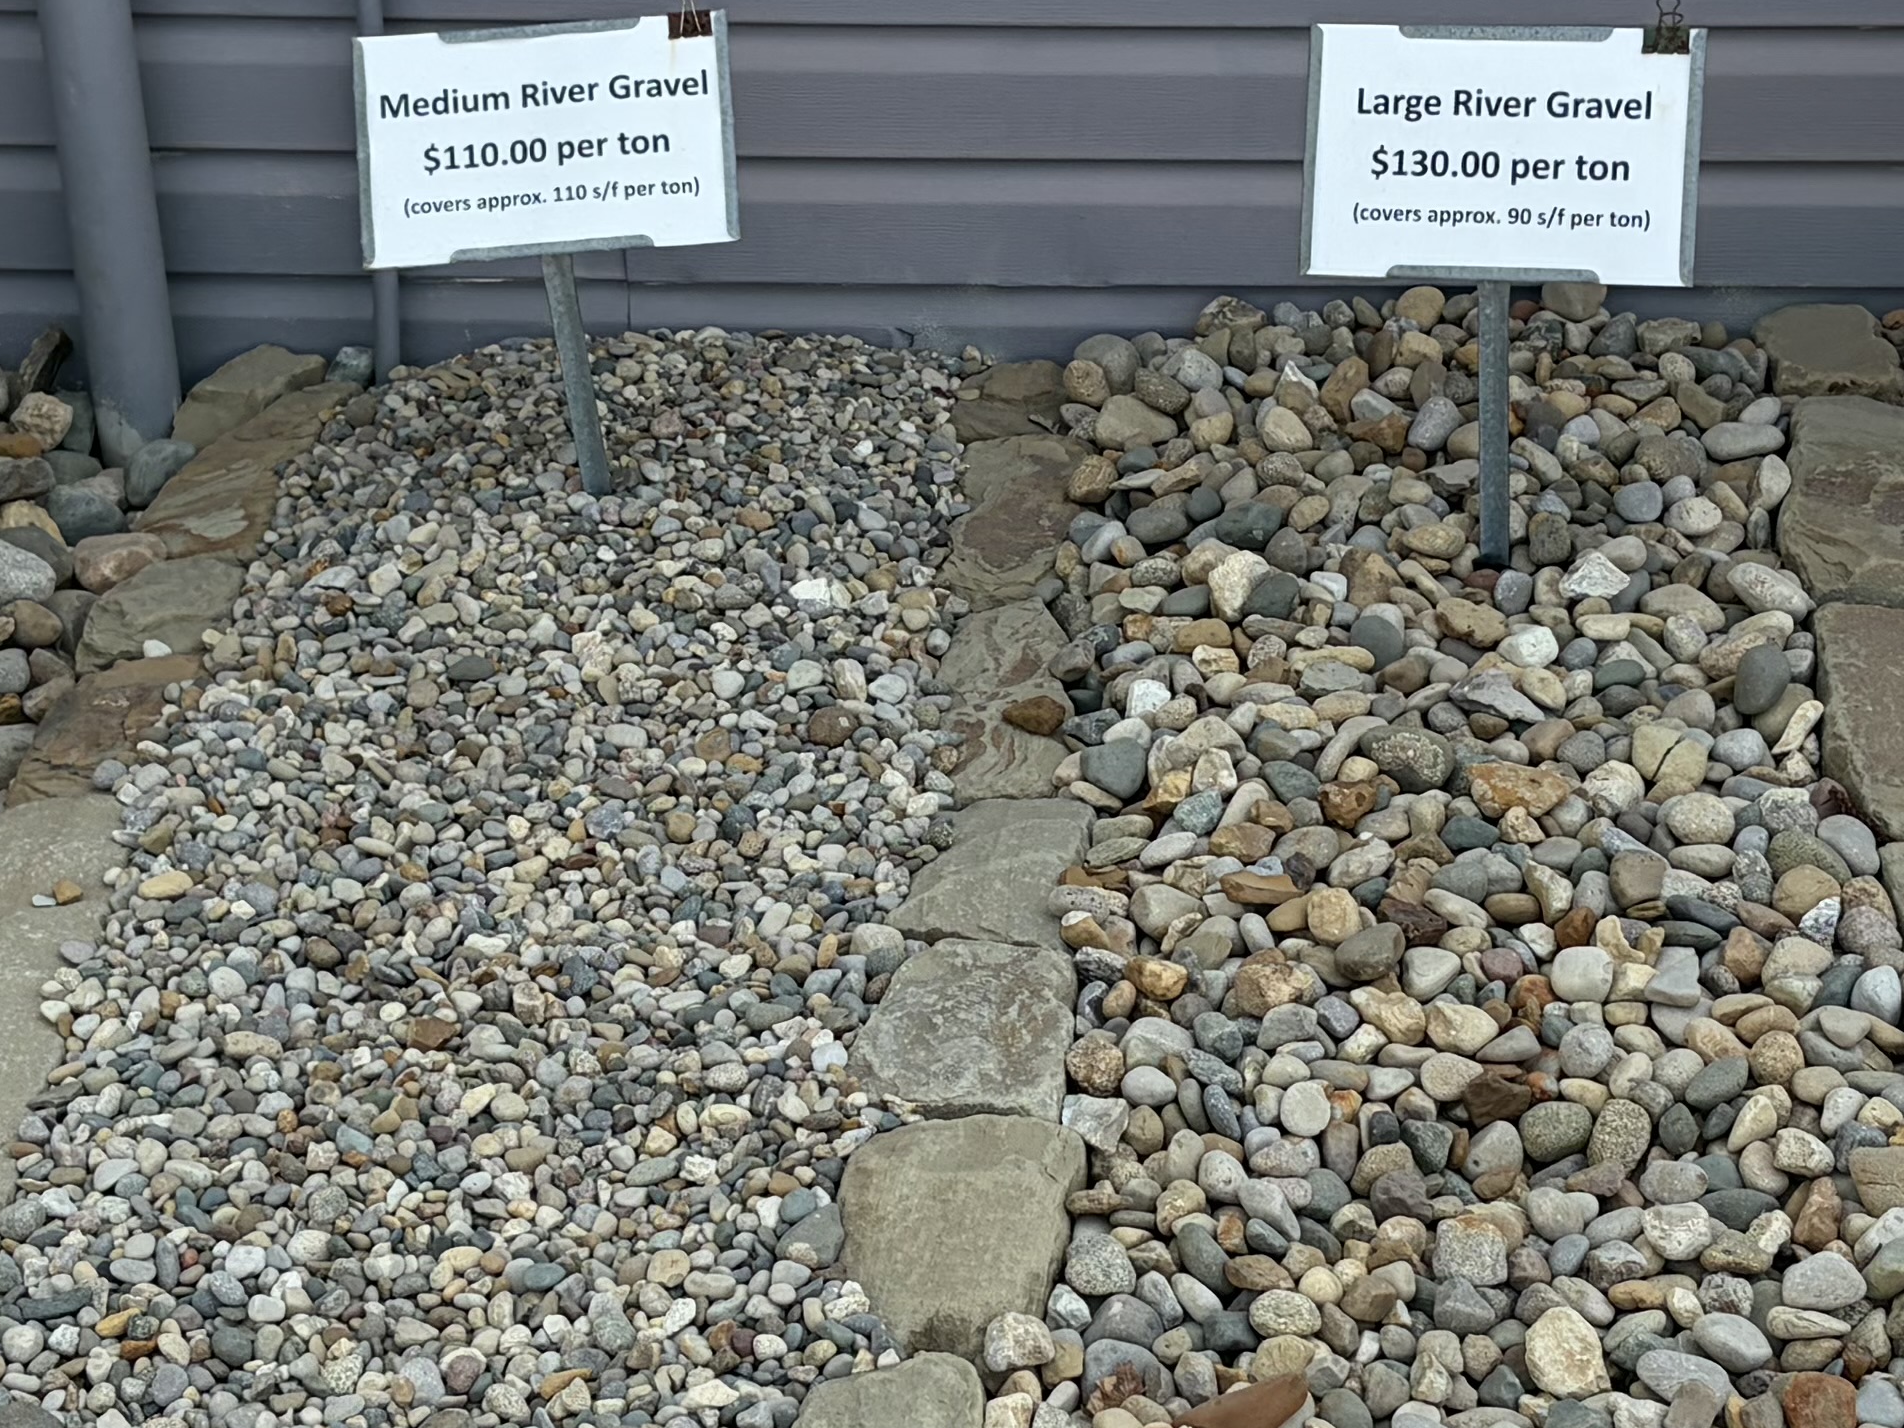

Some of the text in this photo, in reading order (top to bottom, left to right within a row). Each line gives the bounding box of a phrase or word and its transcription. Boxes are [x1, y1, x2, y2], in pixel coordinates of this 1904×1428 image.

[380, 68, 709, 119] Medium River Gravel
[1357, 87, 1652, 123] Large River Gravel
[423, 132, 670, 176] $110.00 per ton
[1370, 144, 1630, 186] $130.00 per ton
[403, 176, 700, 219] (covers approx. 110 s/f per ton)
[1352, 202, 1651, 232] (covers approx. 90 s/f per ton)
